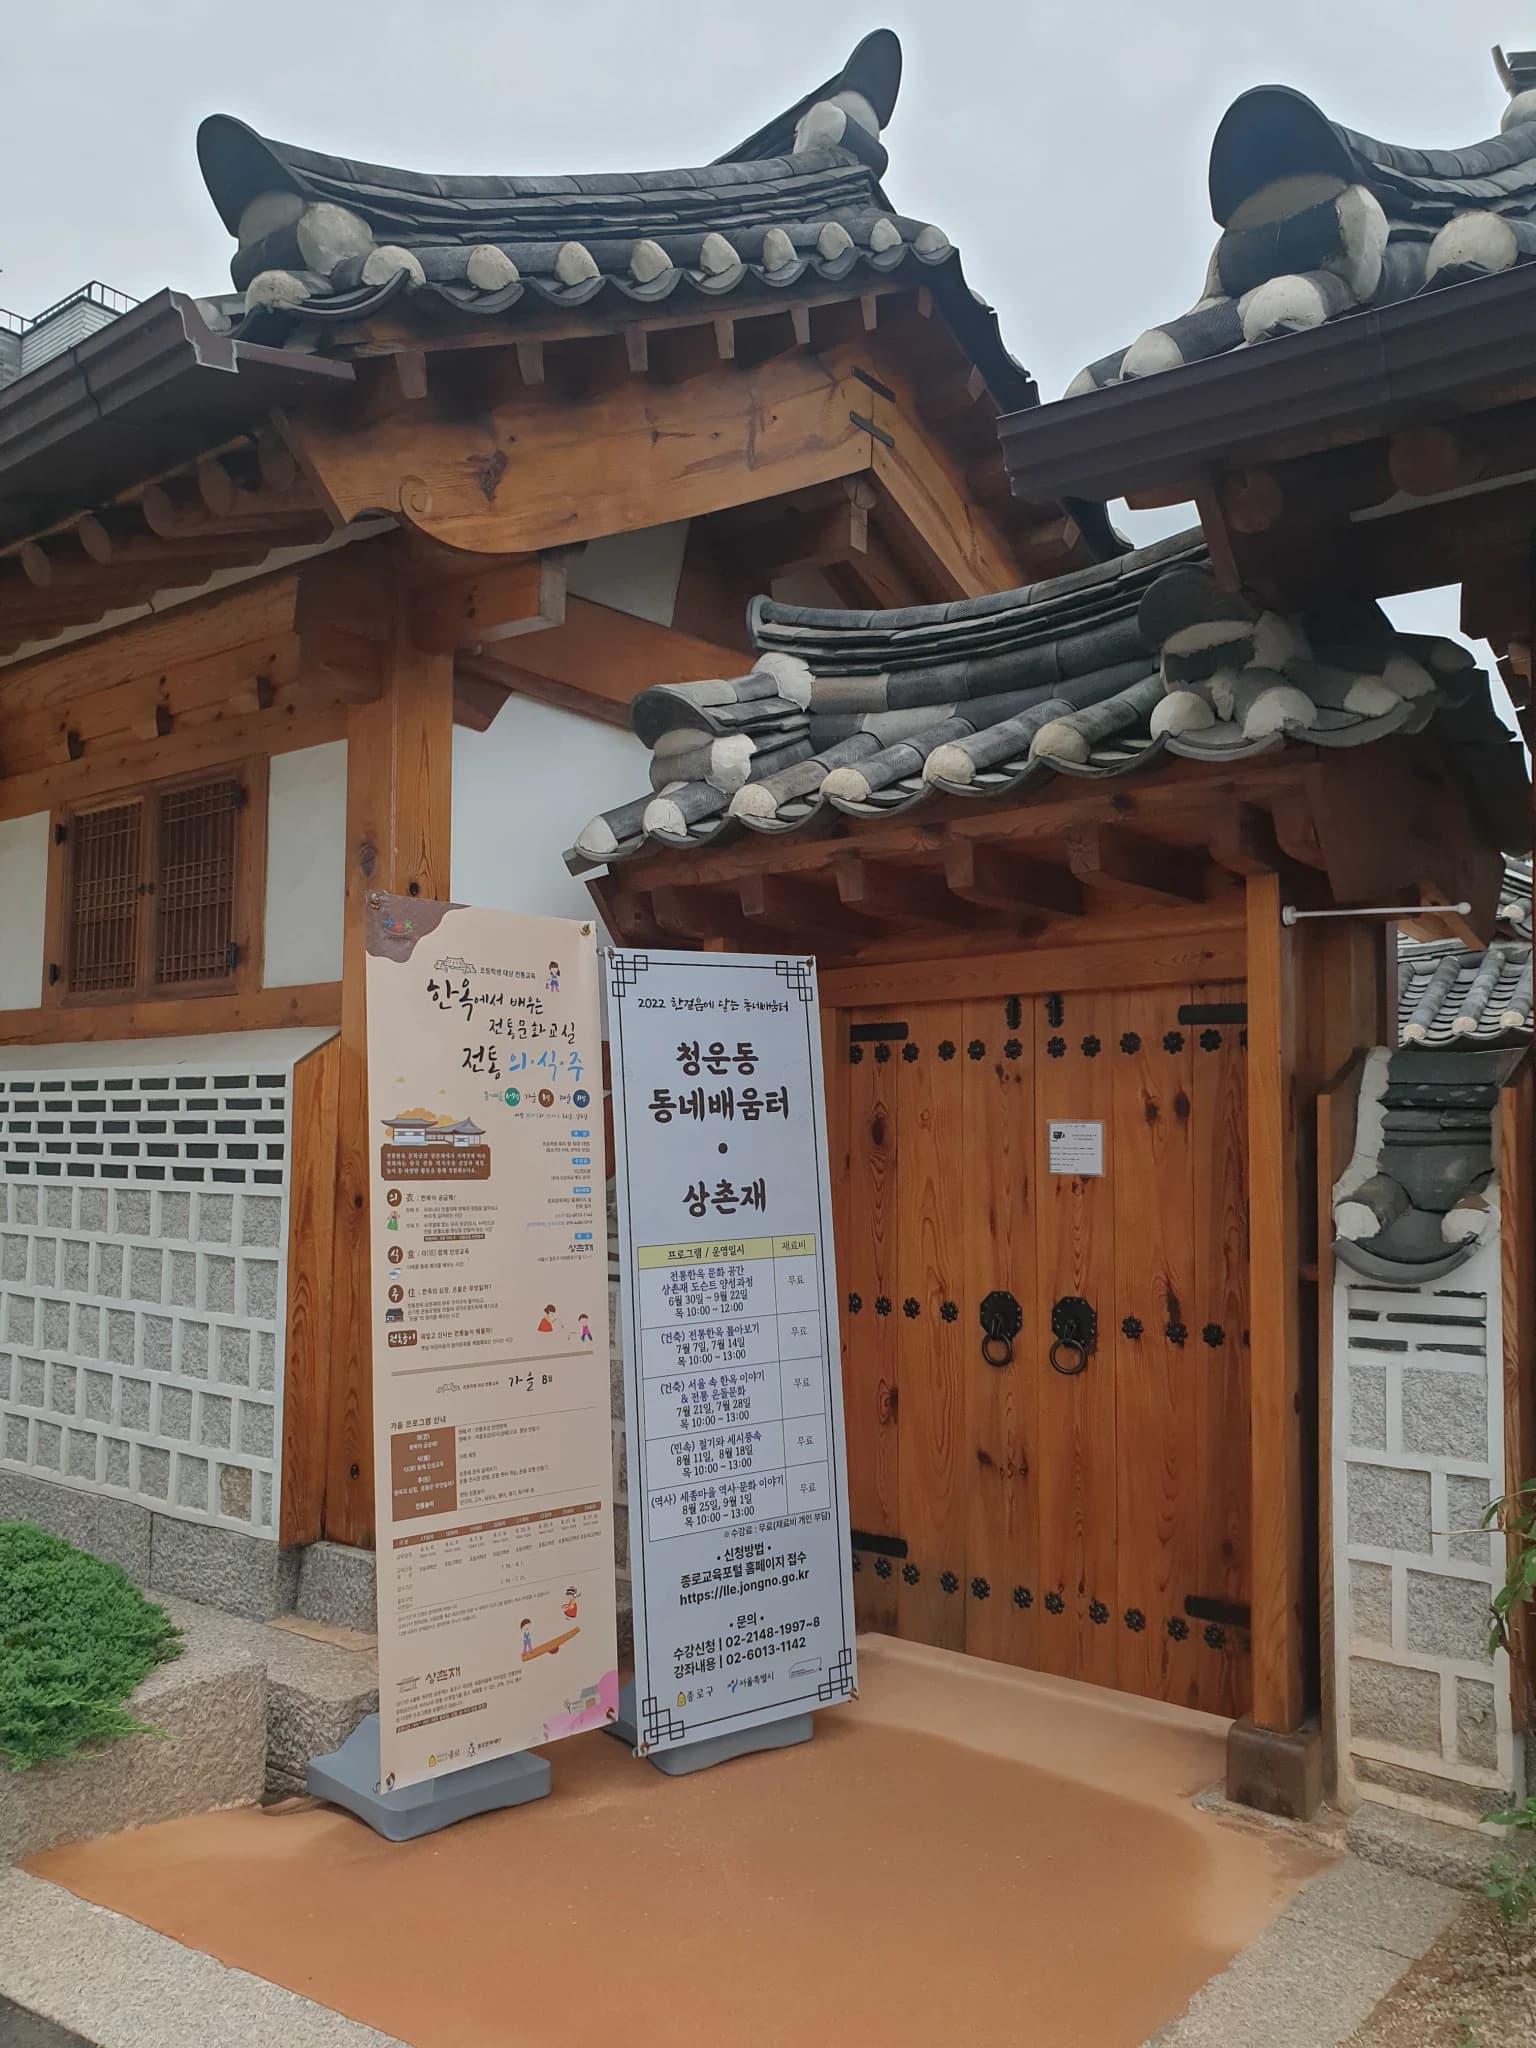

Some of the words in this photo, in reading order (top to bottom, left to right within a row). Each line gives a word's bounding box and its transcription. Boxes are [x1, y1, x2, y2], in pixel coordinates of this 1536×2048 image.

[479, 966, 502, 976] 초등학생
[503, 969, 514, 978] 대상
[515, 971, 536, 980] 전통교육
[427, 978, 504, 1022] 한옥에서
[510, 996, 544, 1015] 배우는
[638, 998, 666, 1009] 2022
[671, 997, 715, 1012] 한걸음에
[718, 1000, 740, 1013] 닿는
[743, 999, 789, 1012] 동네배움터
[489, 1018, 575, 1045] 전통문화교실
[462, 1045, 501, 1080] 전통
[676, 1040, 759, 1076] 청운동
[648, 1085, 789, 1124] 동네배움터
[682, 1177, 767, 1218] 상촌재
[668, 1248, 702, 1260] 프로그램
[712, 1244, 745, 1258] 운영일시
[782, 1239, 806, 1251] 재료비
[670, 1268, 706, 1282] 전통한옥
[708, 1266, 725, 1279] 문화
[728, 1265, 745, 1277] 공간
[787, 1274, 805, 1286] 무료
[661, 1281, 688, 1296] 상촌재
[691, 1280, 718, 1293] 도슨트
[719, 1276, 754, 1291] 양성과정
[668, 1295, 683, 1307] 6월
[685, 1293, 704, 1305] 30일
[713, 1291, 727, 1302] 9월
[730, 1289, 748, 1300] 22일
[675, 1307, 685, 1319] 목
[687, 1305, 711, 1317] 10:00
[721, 1302, 744, 1313] 12:00
[660, 1329, 686, 1345] (건축)
[689, 1326, 724, 1341] 전통한옥
[791, 1325, 808, 1337] 무료
[676, 1343, 691, 1355] 7월
[693, 1340, 709, 1353] 7일,
[711, 1339, 725, 1350] 7월
[728, 1336, 745, 1349] 14일
[677, 1356, 687, 1368] 목
[689, 1353, 713, 1366] 10:00
[723, 1349, 746, 1361] 13:00
[508, 1371, 534, 1392] 가을
[660, 1381, 685, 1395] (건축)
[688, 1378, 706, 1392] 서울
[708, 1376, 718, 1388] 속
[720, 1374, 738, 1387] 한옥
[739, 1369, 765, 1384] 이야기
[793, 1377, 811, 1389] 무료
[680, 1393, 689, 1404] &
[692, 1390, 709, 1403] 전통
[711, 1385, 746, 1400] 온돌문화
[676, 1405, 691, 1417] 7월
[693, 1402, 714, 1416] 21일,
[717, 1399, 731, 1411] 7월
[733, 1396, 751, 1409] 28일
[390, 1418, 404, 1430] 가을
[405, 1416, 432, 1428] 프로그램
[433, 1415, 447, 1425] 안내
[680, 1418, 690, 1431] 목
[692, 1415, 716, 1427] 10:00
[726, 1410, 750, 1422] 13:00
[670, 1440, 695, 1456] (민속)
[699, 1434, 725, 1451] 절기와
[727, 1430, 763, 1445] 세시풍속
[797, 1435, 814, 1447] 무료
[676, 1454, 691, 1466] 8월
[693, 1450, 714, 1464] 11일,
[719, 1448, 733, 1460] 8월
[735, 1444, 753, 1457] 18일
[682, 1466, 692, 1479] 목
[694, 1463, 719, 1476] 10:00
[728, 1457, 752, 1470] 13:00
[651, 1493, 677, 1509] (역사)
[680, 1487, 716, 1503] 세종마을
[759, 1474, 784, 1488] 이야기
[800, 1482, 817, 1494] 무료
[682, 1503, 697, 1515] 8월
[699, 1499, 720, 1512] 25일,
[723, 1495, 737, 1507] 9월
[740, 1493, 753, 1505] 1일
[684, 1515, 694, 1528] 목
[697, 1512, 721, 1526] 10:00
[731, 1506, 755, 1519] 13:00
[799, 1515, 813, 1527] 개인
[814, 1511, 831, 1524] 부담)
[724, 1542, 765, 1562] 신청방법
[680, 1563, 743, 1589] 종로교육포털
[745, 1554, 785, 1575] 홈페이지
[787, 1550, 807, 1567] 접수
[679, 1568, 810, 1606] https://lle.jongno.go.kr
[736, 1612, 757, 1630] 문의
[673, 1639, 716, 1661] 수강신청
[725, 1616, 820, 1649] 02-2148-1997~8
[673, 1658, 717, 1680] 강좌내용
[726, 1637, 806, 1666] 02-6013-1142
[425, 1666, 461, 1685] 상촌재
[739, 1672, 775, 1689] 서울특별시
[687, 1685, 714, 1702] 종로구
